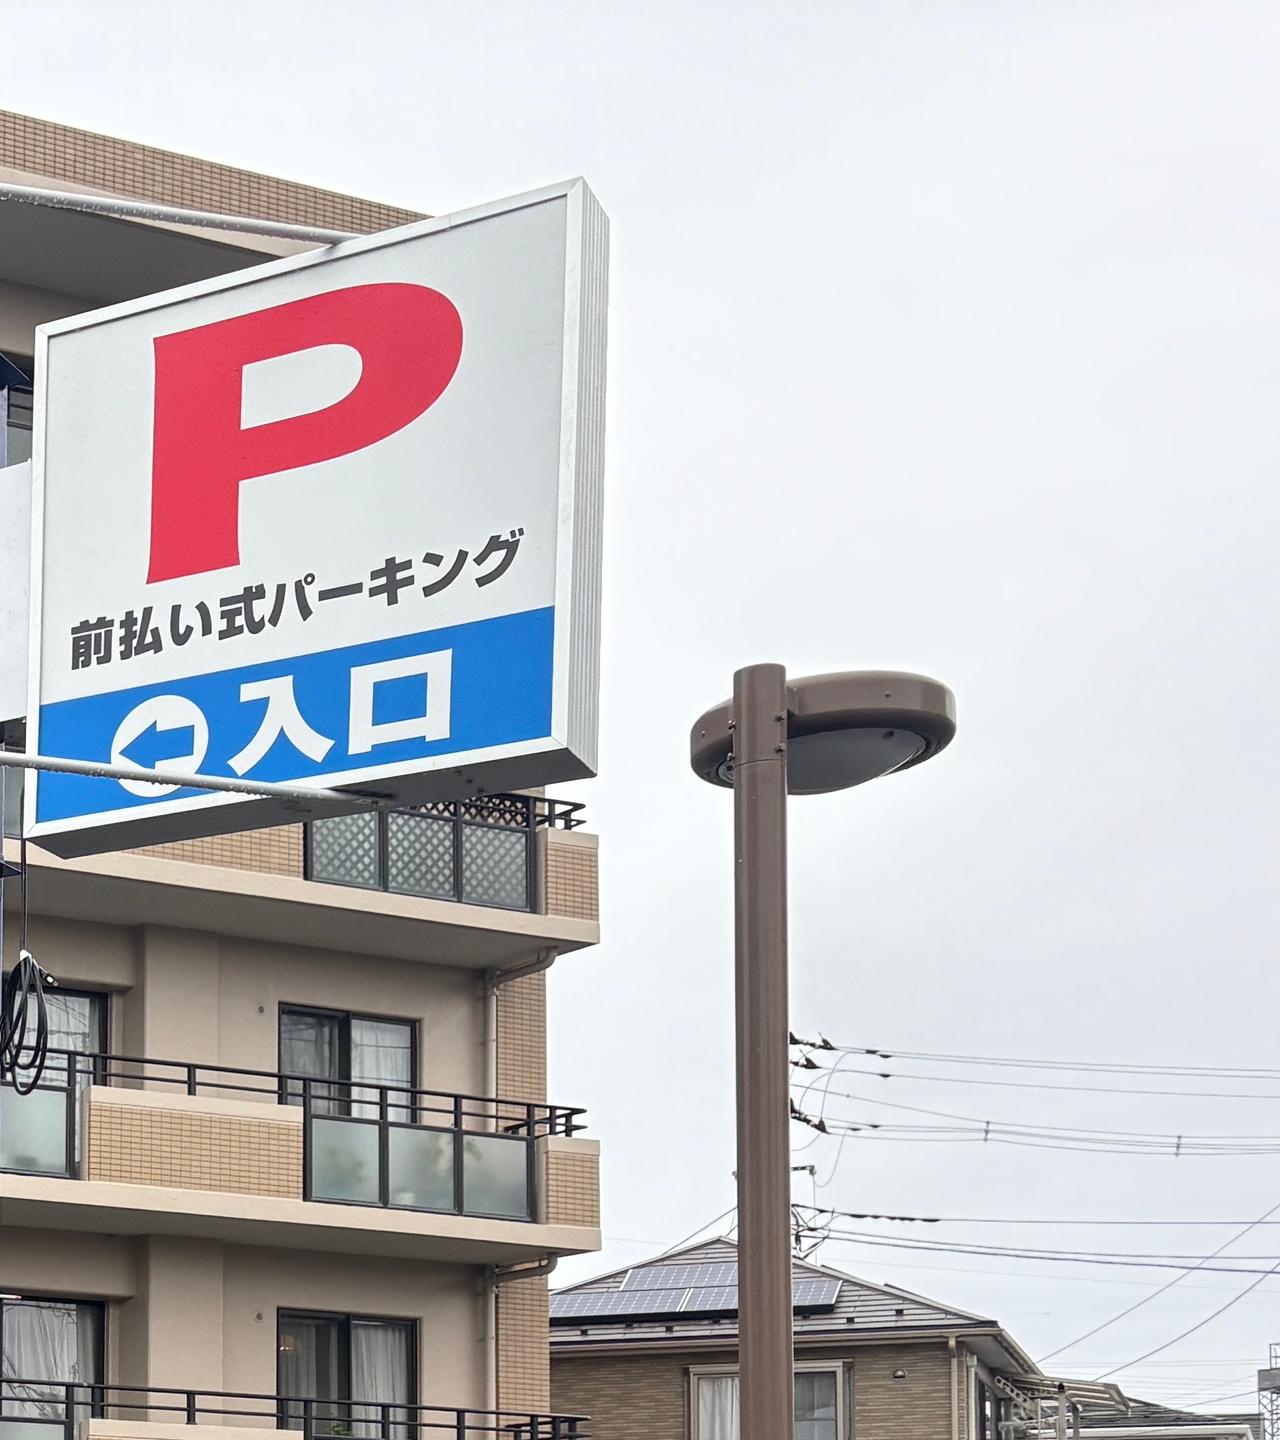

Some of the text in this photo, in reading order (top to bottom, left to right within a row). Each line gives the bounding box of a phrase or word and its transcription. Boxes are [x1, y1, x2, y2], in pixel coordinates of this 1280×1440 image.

[146, 282, 463, 584] P
[70, 528, 525, 670] 前払い式パーキング
[227, 648, 453, 776] 入口
